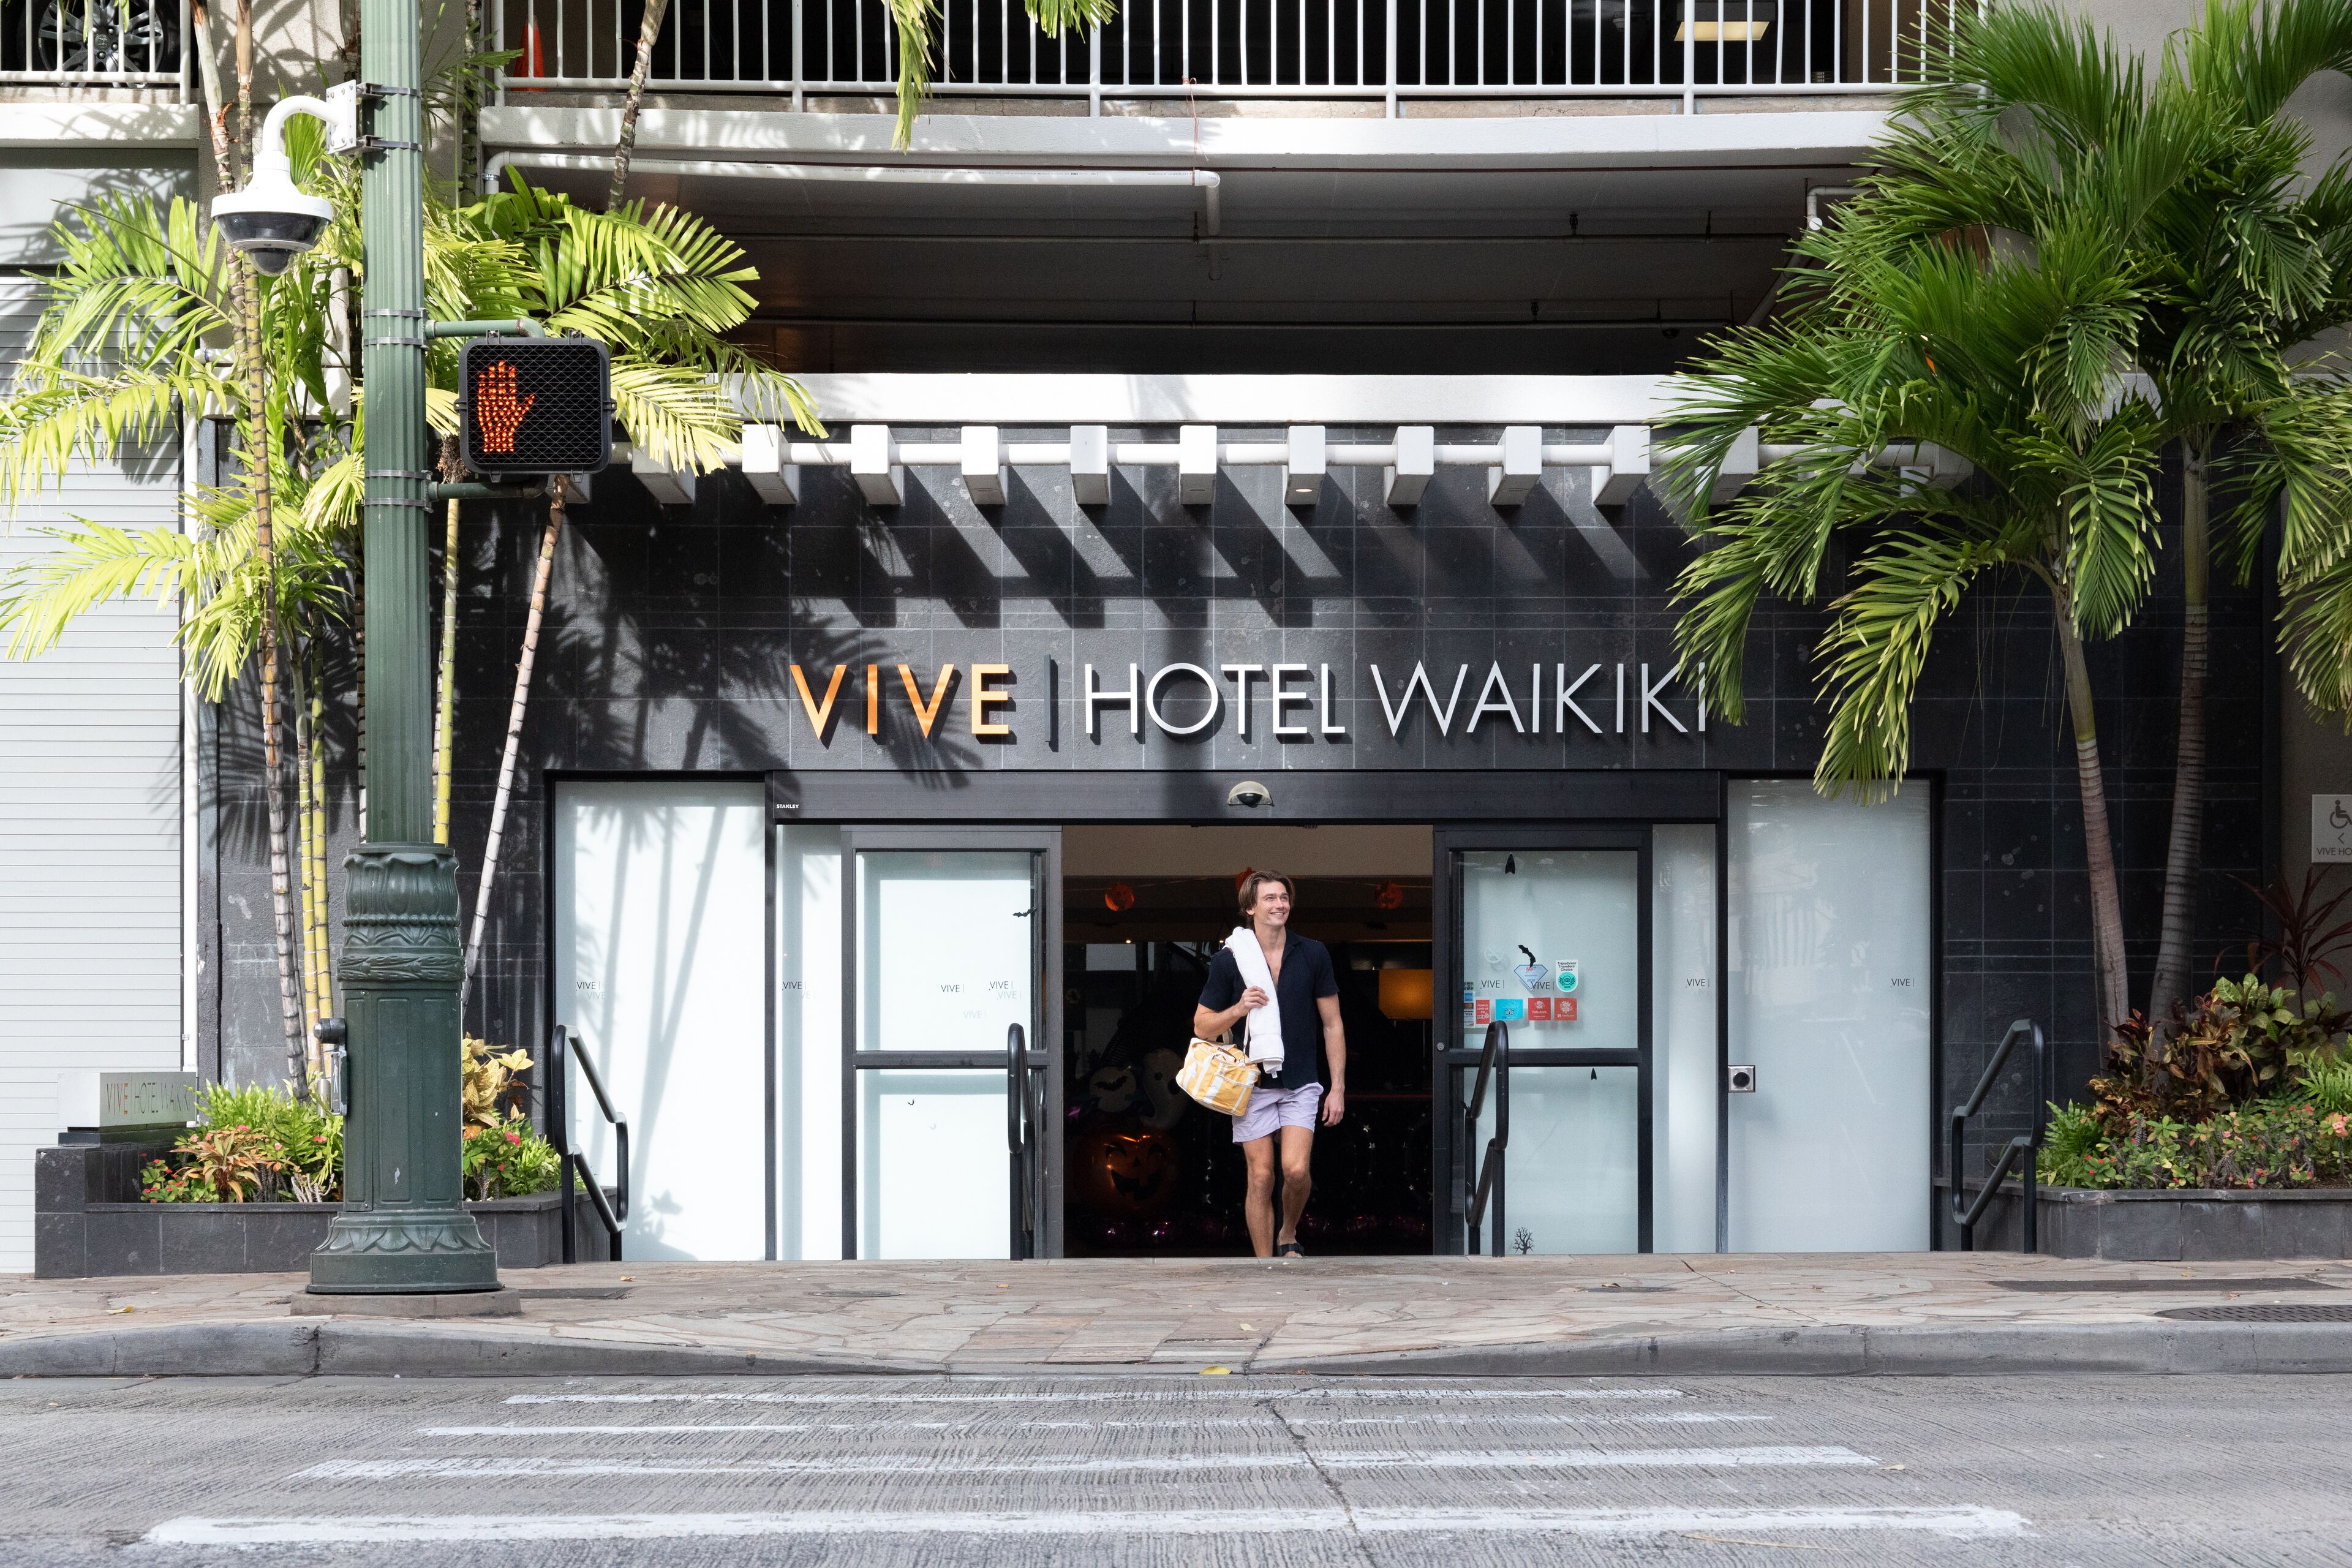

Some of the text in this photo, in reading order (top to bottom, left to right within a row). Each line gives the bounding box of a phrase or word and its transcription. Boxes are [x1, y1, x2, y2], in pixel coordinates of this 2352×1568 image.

[790, 660, 1706, 739] VIVE HOTEL WAIKIKI
[2316, 847, 2335, 856] VIVE
[1531, 981, 1550, 990] VIVE
[1891, 978, 1910, 987] VIVE
[106, 1083, 128, 1115] VIVE
